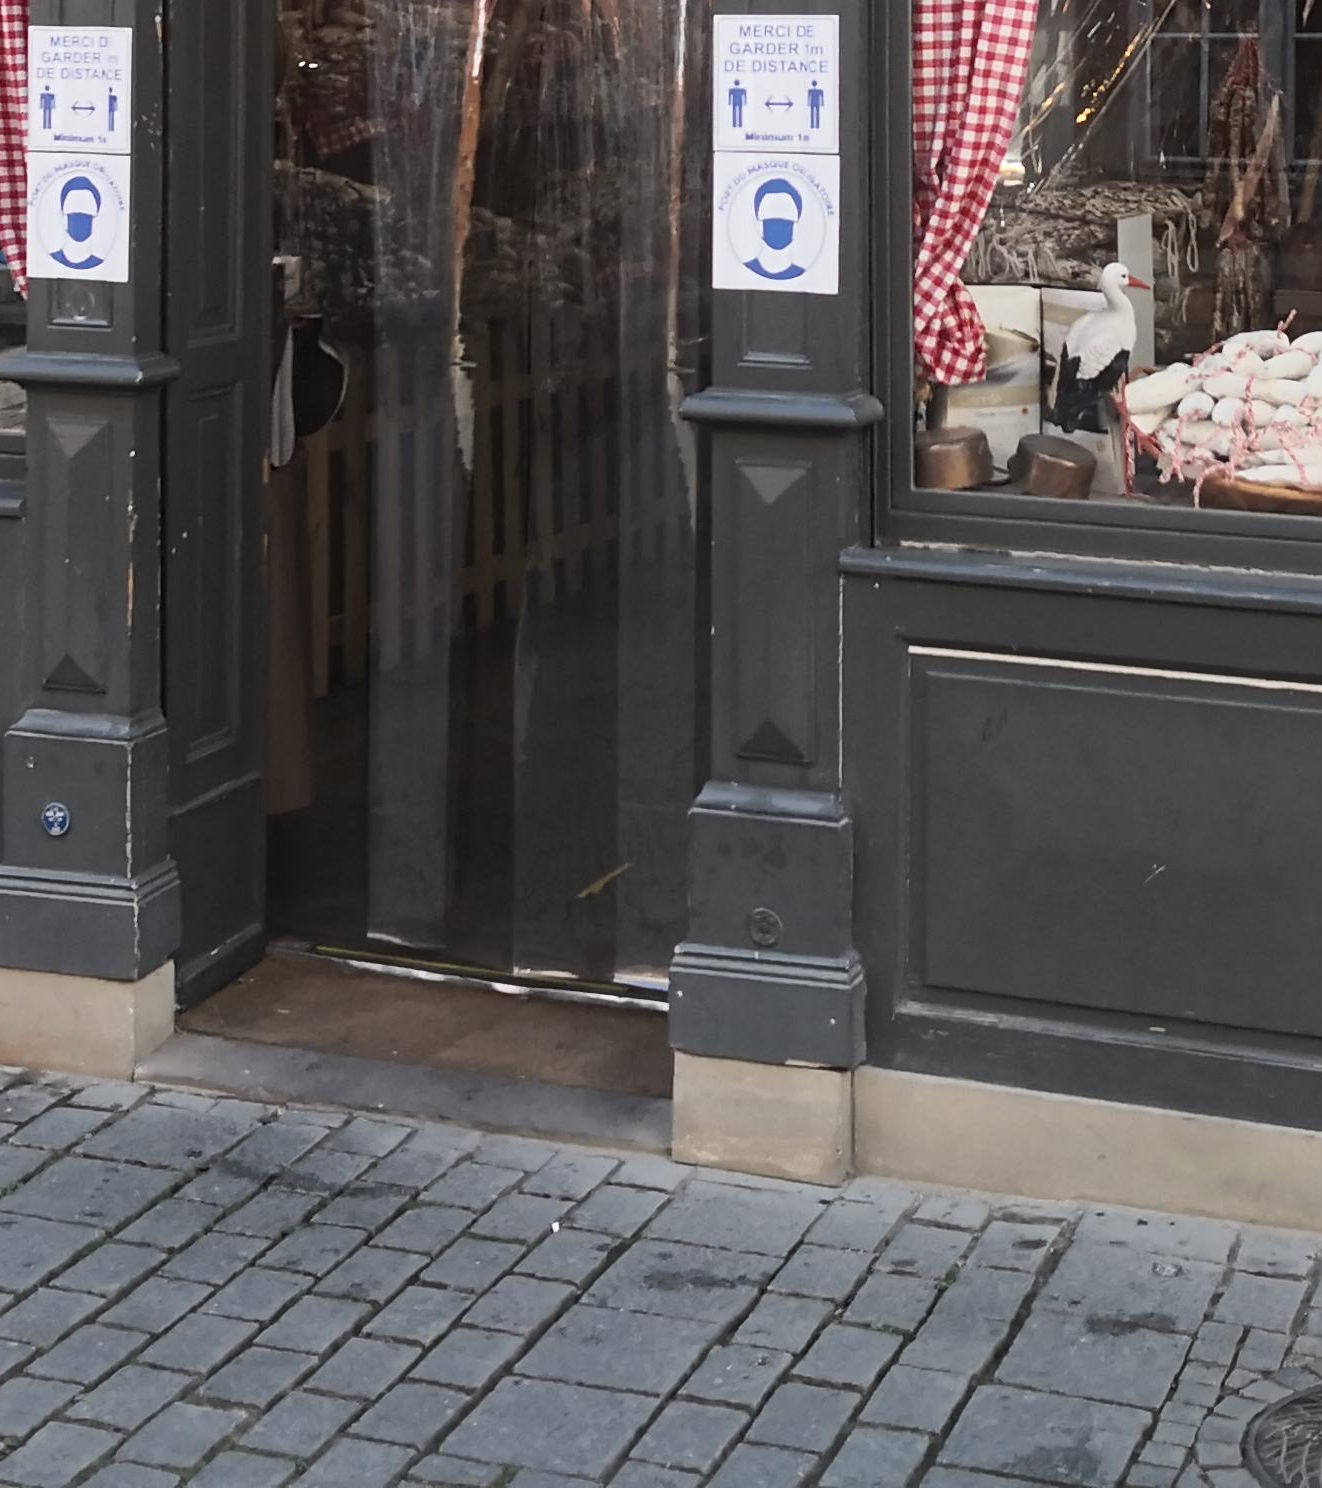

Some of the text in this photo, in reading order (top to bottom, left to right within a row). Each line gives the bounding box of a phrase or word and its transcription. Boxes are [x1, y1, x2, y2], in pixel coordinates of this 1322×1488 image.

[739, 25, 815, 38] MERCI DE
[50, 35, 95, 48] MERCI
[728, 41, 800, 55] GARDER
[41, 51, 102, 64] GARDER
[724, 59, 830, 74] DE DISTANCE
[36, 67, 123, 81] DE DISTANCE
[745, 131, 794, 142] Minimum
[747, 160, 789, 174] MASQUE
